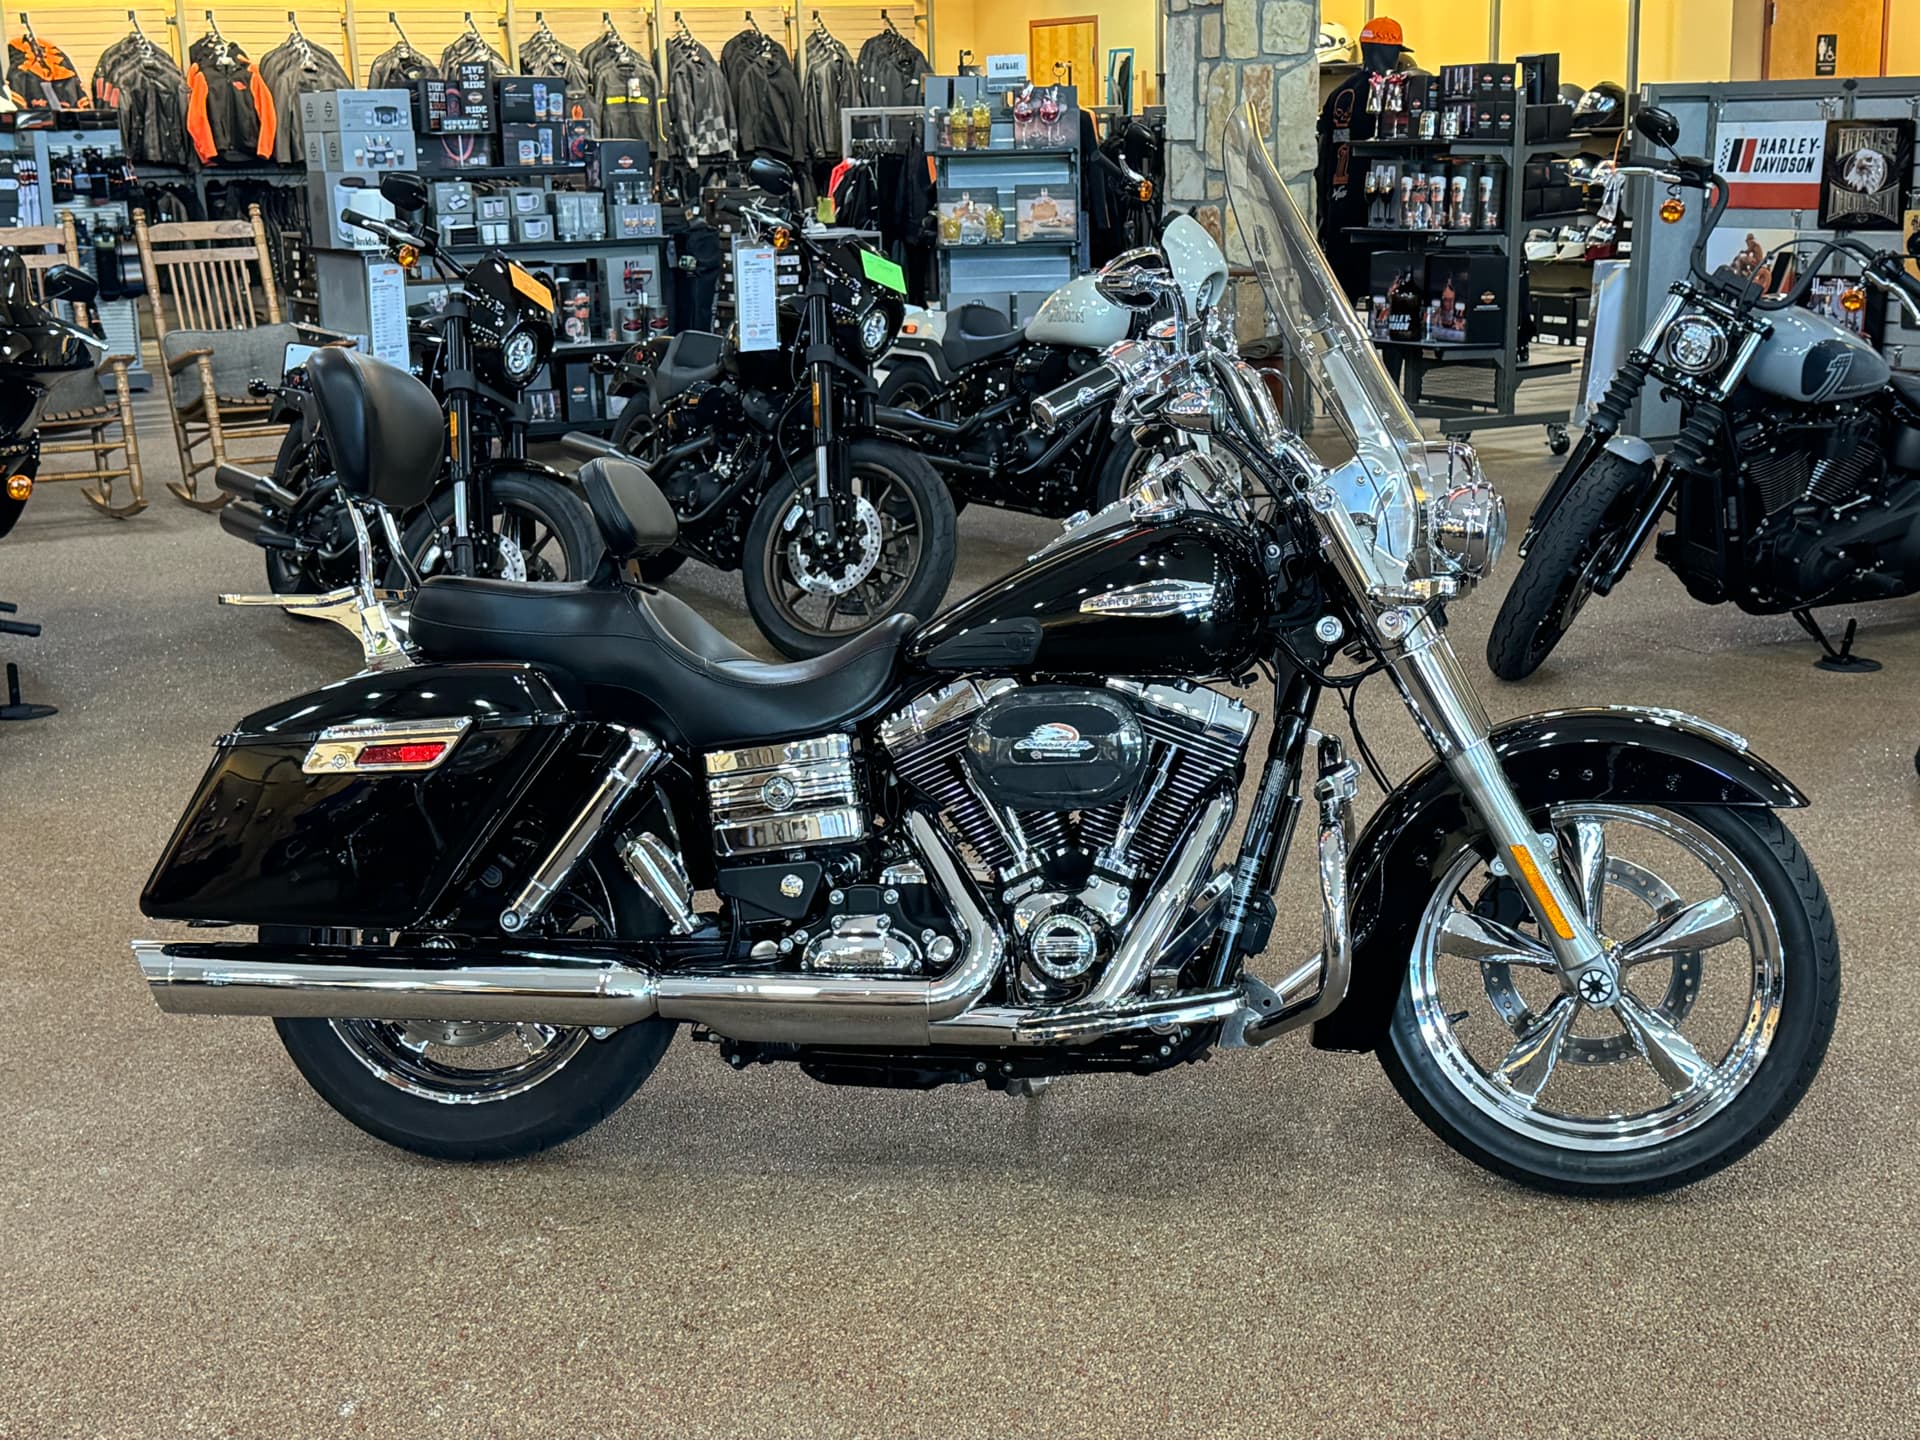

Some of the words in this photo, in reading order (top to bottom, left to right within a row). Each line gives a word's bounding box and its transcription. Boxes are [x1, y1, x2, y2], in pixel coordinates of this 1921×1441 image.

[462, 66, 484, 74] LIVE
[463, 81, 485, 89] RIDE
[465, 105, 487, 113] RIDE
[1759, 138, 1820, 154] HARLEY-
[1753, 157, 1815, 173] DAVIDSON
